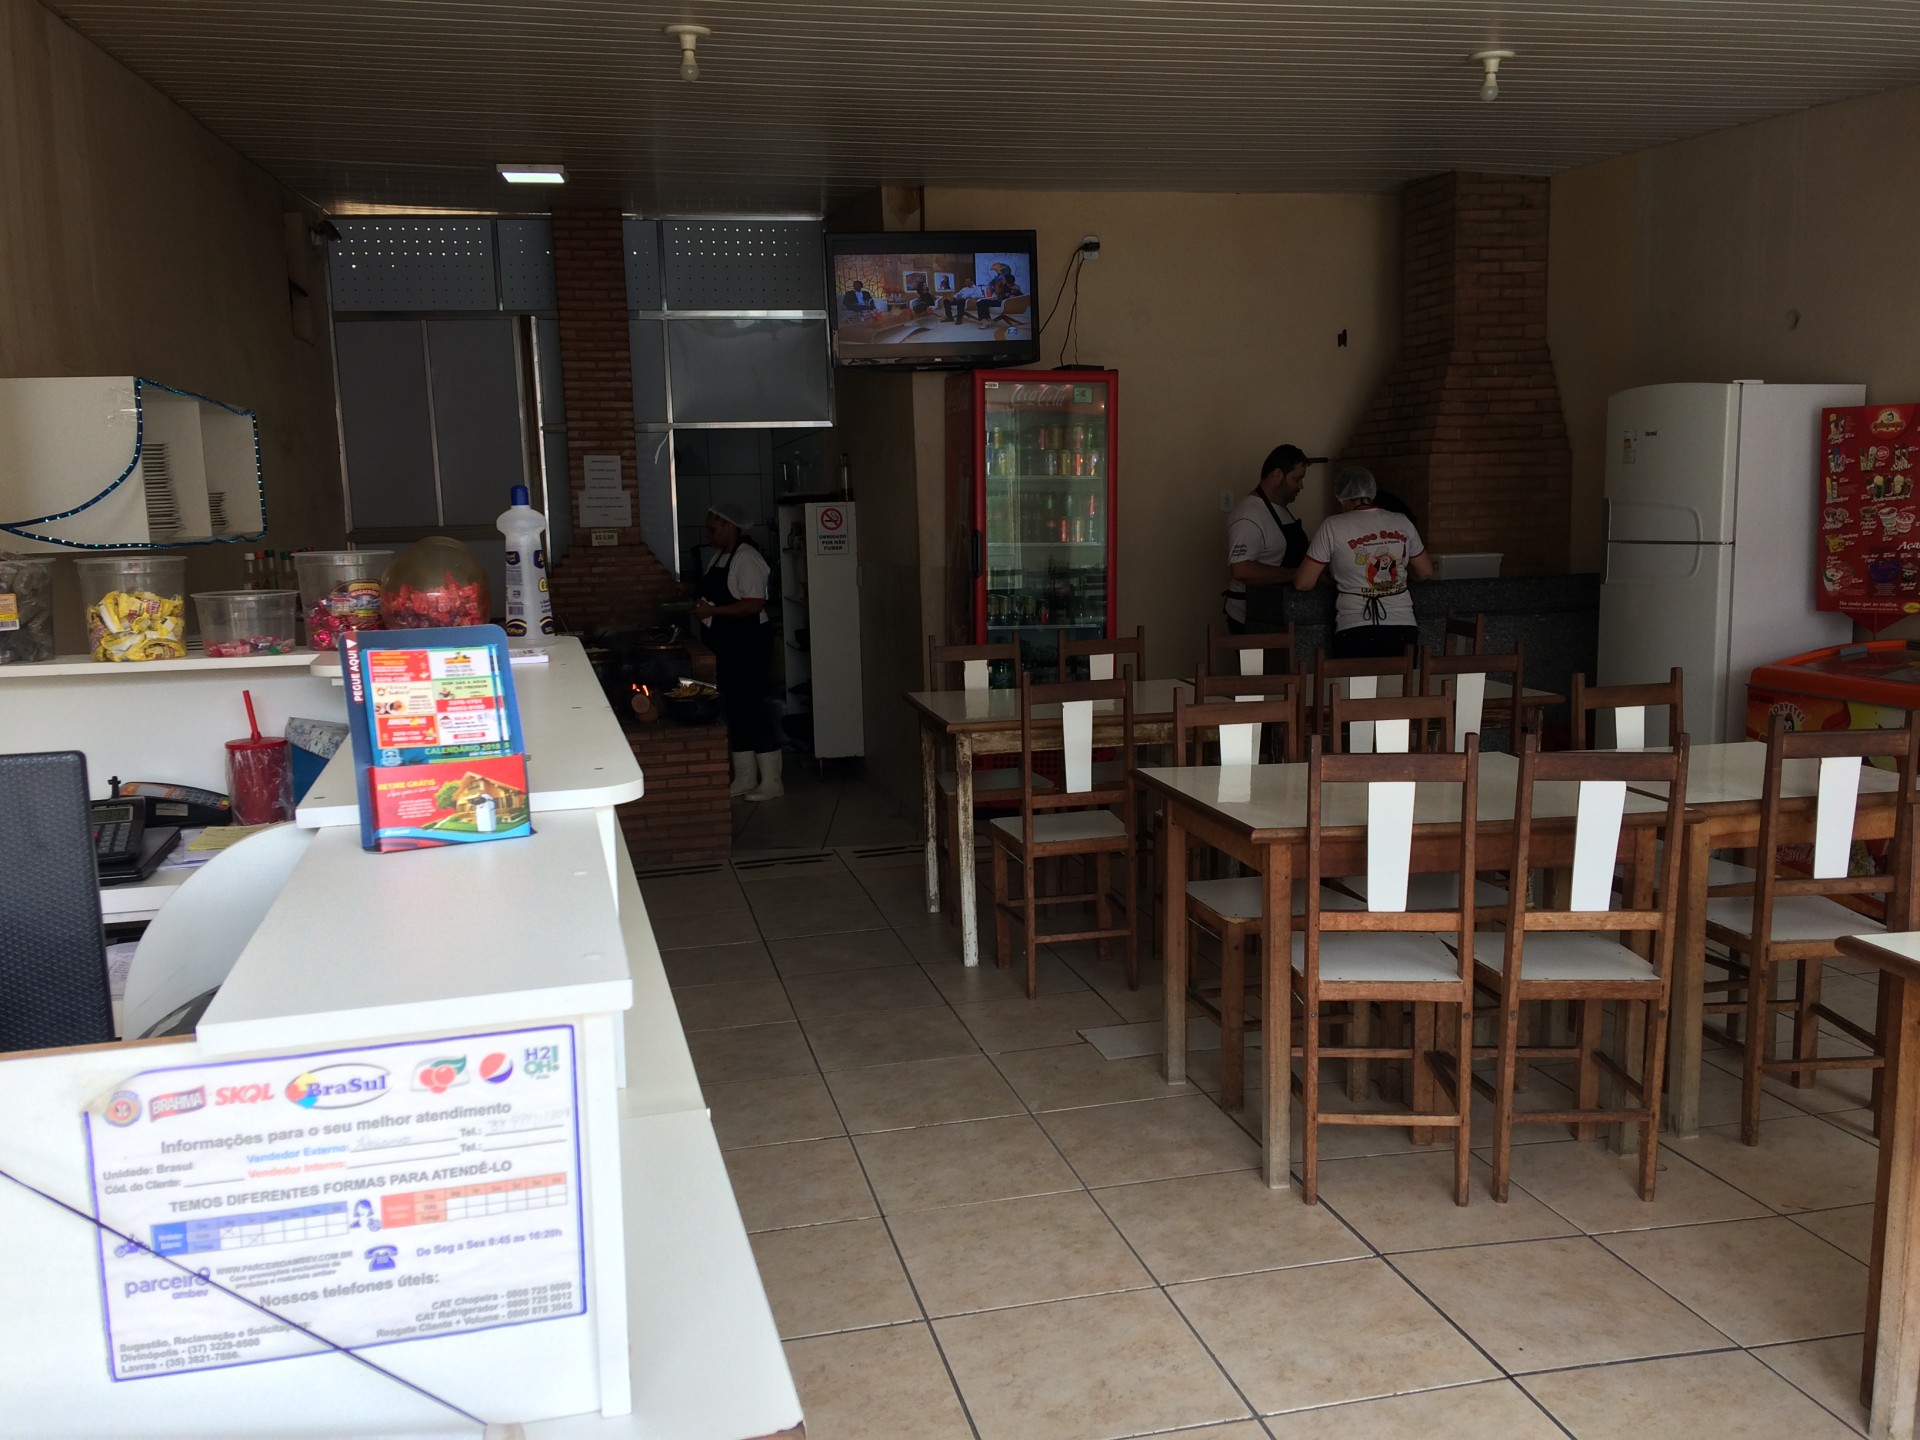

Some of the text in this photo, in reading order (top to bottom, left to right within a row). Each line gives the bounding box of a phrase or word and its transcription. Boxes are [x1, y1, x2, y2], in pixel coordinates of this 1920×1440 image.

[347, 650, 363, 701] PEGUE AQUI
[425, 745, 480, 755] CALENDÁRIO
[482, 743, 501, 751] 2018
[306, 1073, 388, 1098] BraSul
[214, 1083, 274, 1106] SKOL
[152, 1092, 203, 1115] BRAHMA
[160, 1132, 263, 1153] Informações
[268, 1128, 304, 1144] para
[309, 1127, 319, 1136] o
[323, 1120, 352, 1134] seu
[356, 1114, 411, 1130] melhor
[416, 1102, 513, 1123] atendimento
[460, 1127, 482, 1138] Tel.:
[460, 1143, 482, 1153] Tel.:
[247, 1148, 300, 1164] Vendedor
[102, 1162, 193, 1180] Unidade: Brasul
[249, 1164, 301, 1179] Vendedor
[130, 1183, 143, 1191] do
[145, 1178, 182, 1190] Cliente:
[169, 1160, 512, 1213] TEMOS DIFERENTES FORMAS PARA ATENDÊ-LO
[416, 1247, 431, 1257] De
[466, 1240, 485, 1249] Sex
[172, 1289, 209, 1300] ambev
[259, 1271, 439, 1308] Nossos telefones úteis:
[432, 1300, 453, 1310] CAT
[416, 1312, 436, 1322] CAT
[121, 1350, 178, 1362] Divinópolis
[121, 1362, 157, 1373] Lavras
